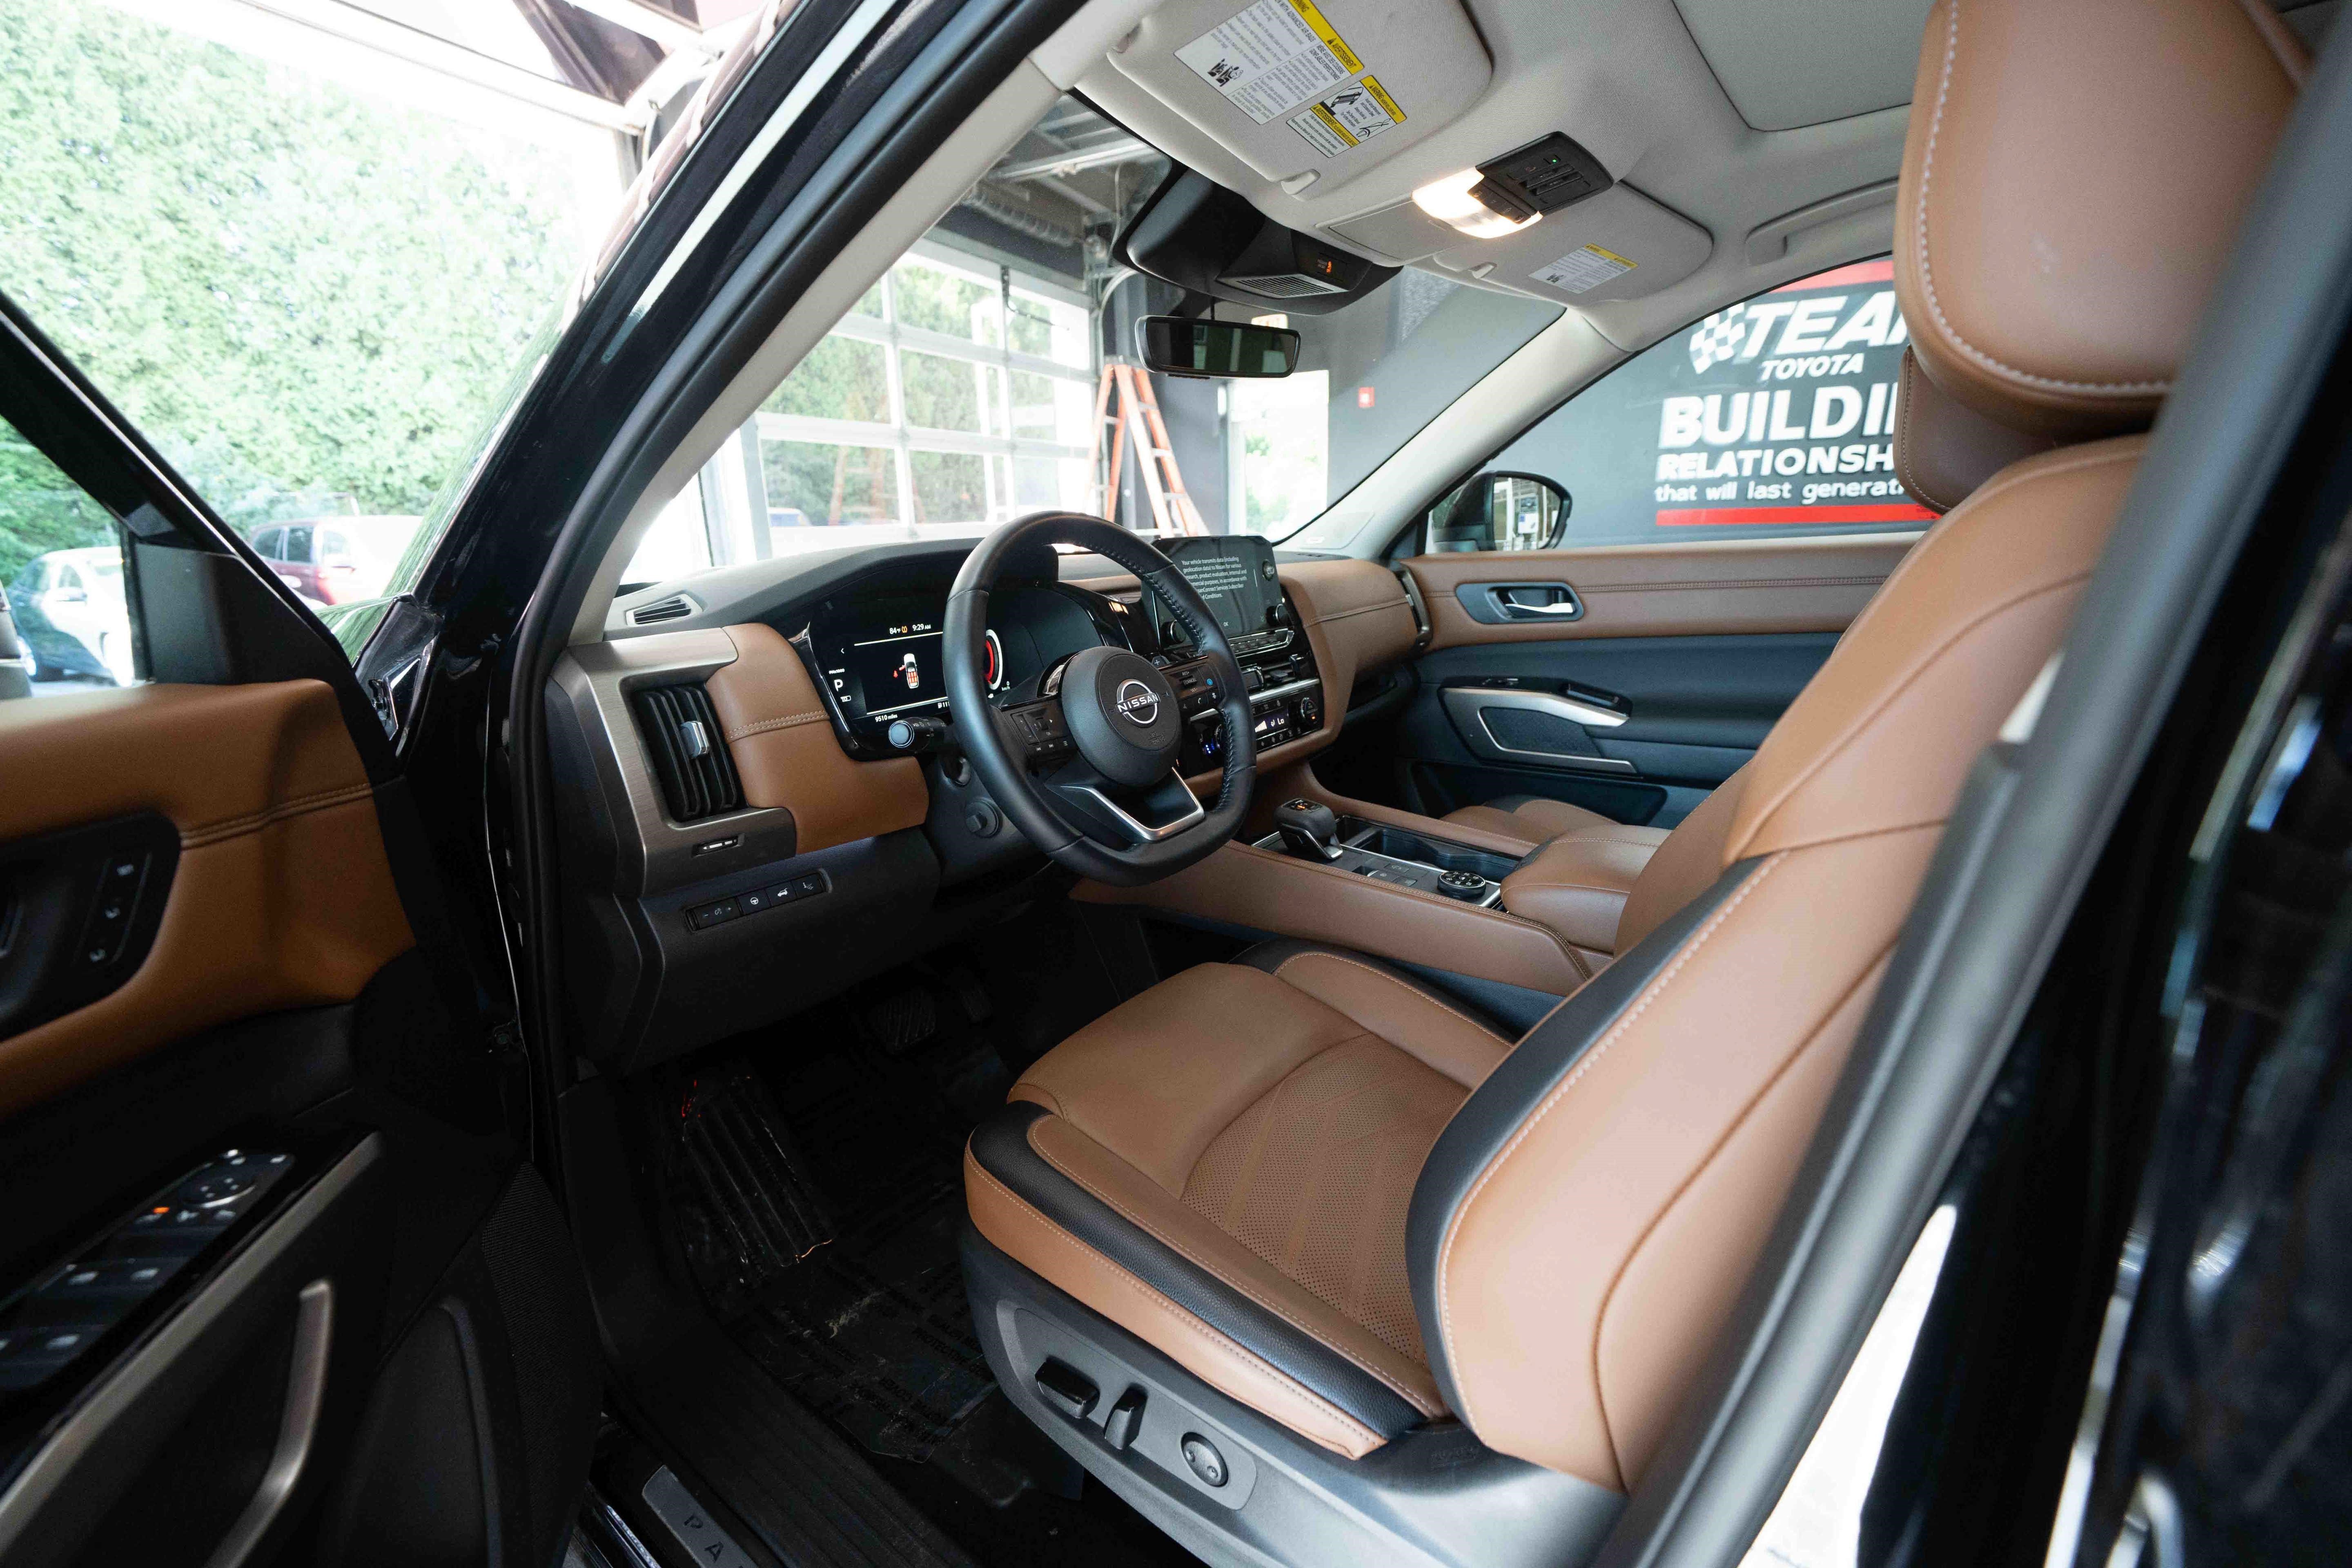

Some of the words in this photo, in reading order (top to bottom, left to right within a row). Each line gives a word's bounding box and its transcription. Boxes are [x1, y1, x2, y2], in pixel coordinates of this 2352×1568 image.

[1331, 41, 1356, 69] AVERTISSEMENT
[1760, 353, 1864, 380] TOYOTA
[1655, 483, 1697, 502] that
[1706, 482, 1737, 500] will
[1747, 480, 1791, 500] last
[834, 679, 843, 691] P
[1117, 694, 1158, 712] NISSAN
